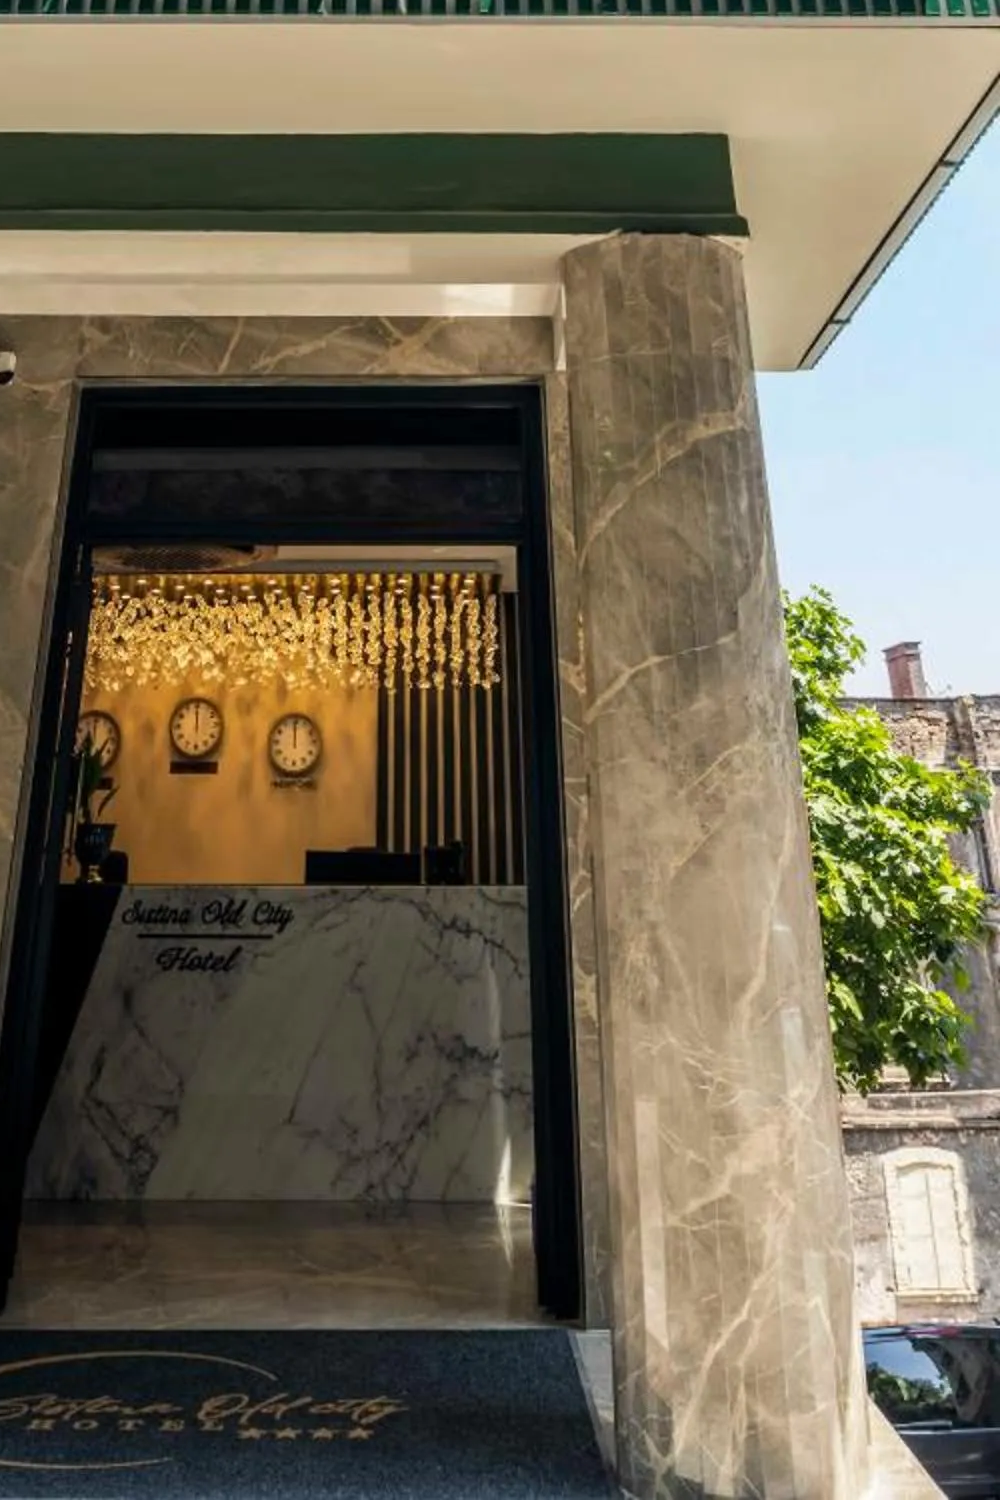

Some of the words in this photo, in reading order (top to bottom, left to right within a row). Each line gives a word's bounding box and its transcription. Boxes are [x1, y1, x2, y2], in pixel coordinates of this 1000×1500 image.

[201, 898, 248, 928] Old
[251, 900, 295, 934] City
[155, 945, 243, 973] Hotel
[197, 1392, 307, 1425] Old
[25, 1418, 226, 1433] HOTEL
